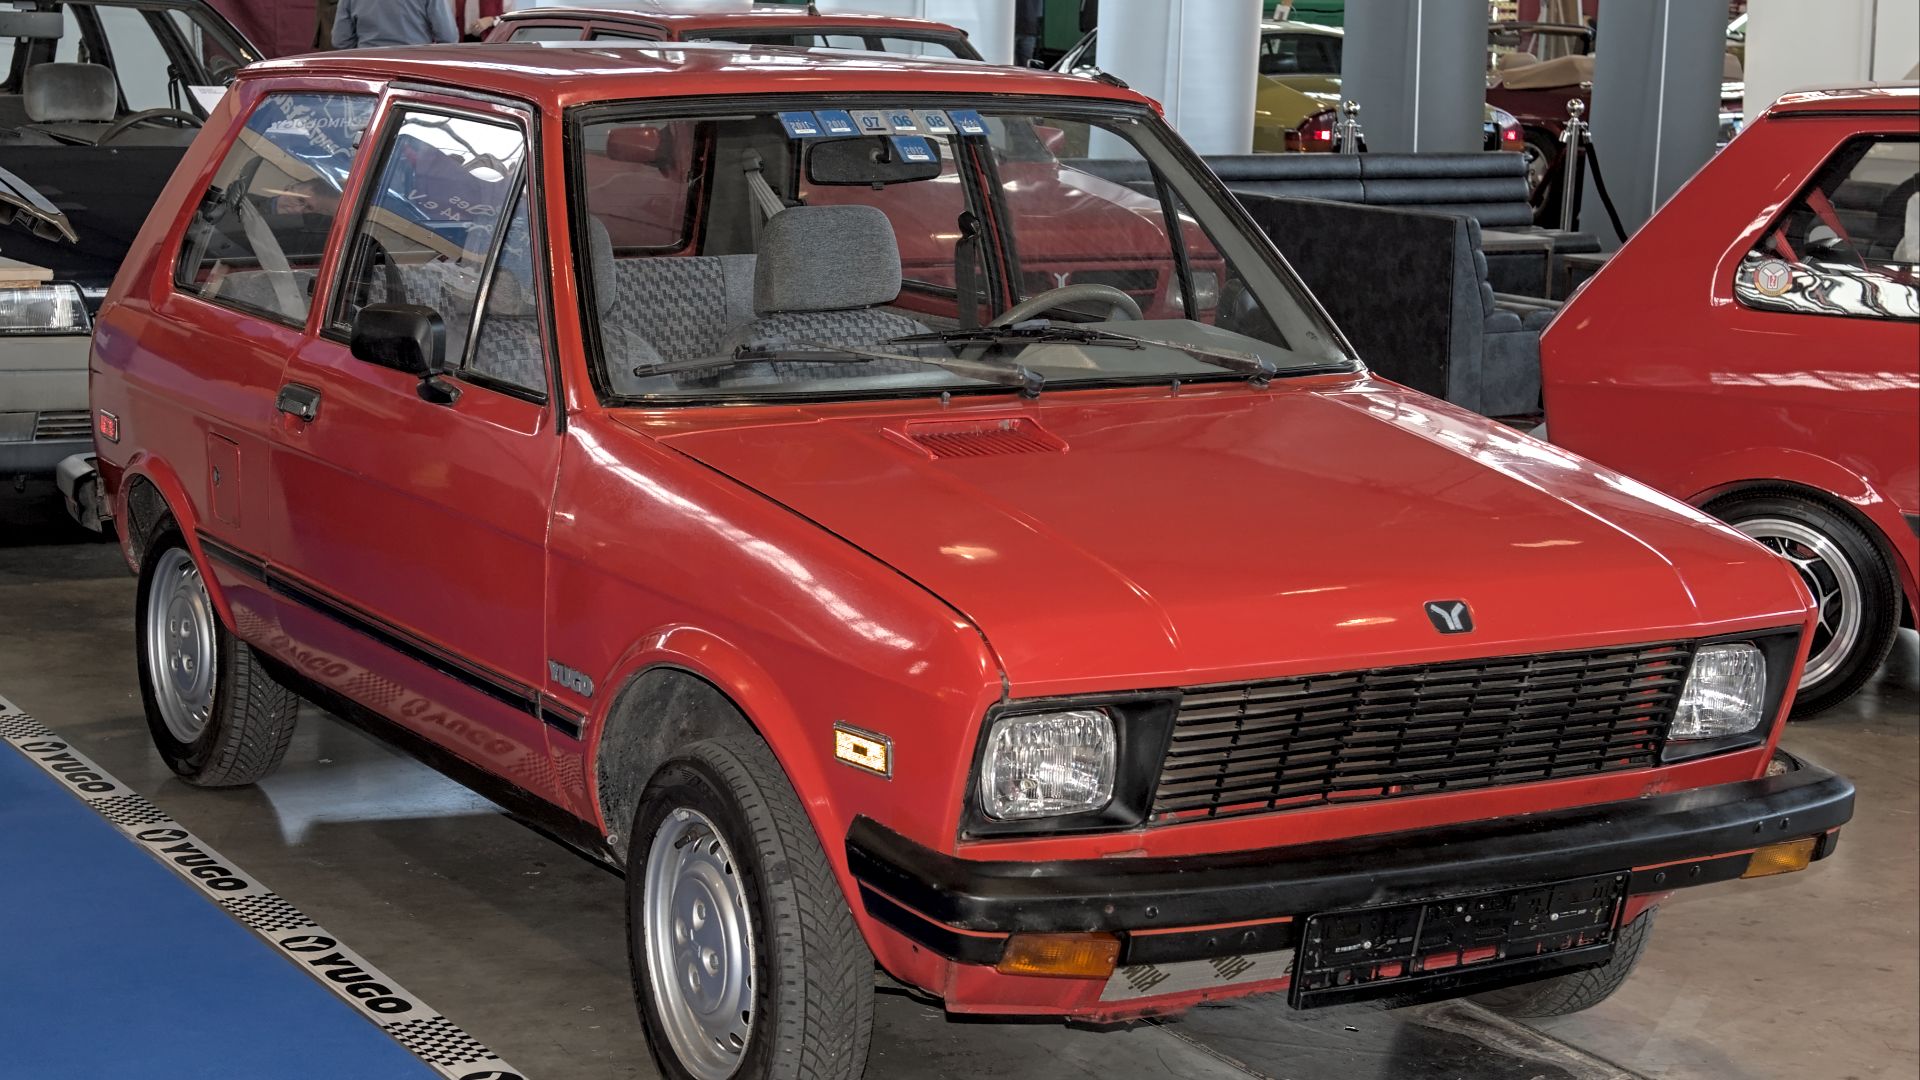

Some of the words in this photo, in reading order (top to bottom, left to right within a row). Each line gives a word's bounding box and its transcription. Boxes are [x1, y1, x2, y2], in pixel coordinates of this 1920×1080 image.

[862, 116, 880, 128] 07
[892, 115, 913, 127] 06
[925, 115, 946, 127] 08
[903, 146, 926, 155] 2012
[547, 659, 594, 698] YUGO
[39, 751, 116, 793] YUGO
[160, 841, 249, 891] YUGO
[307, 951, 413, 1014] YUGO
